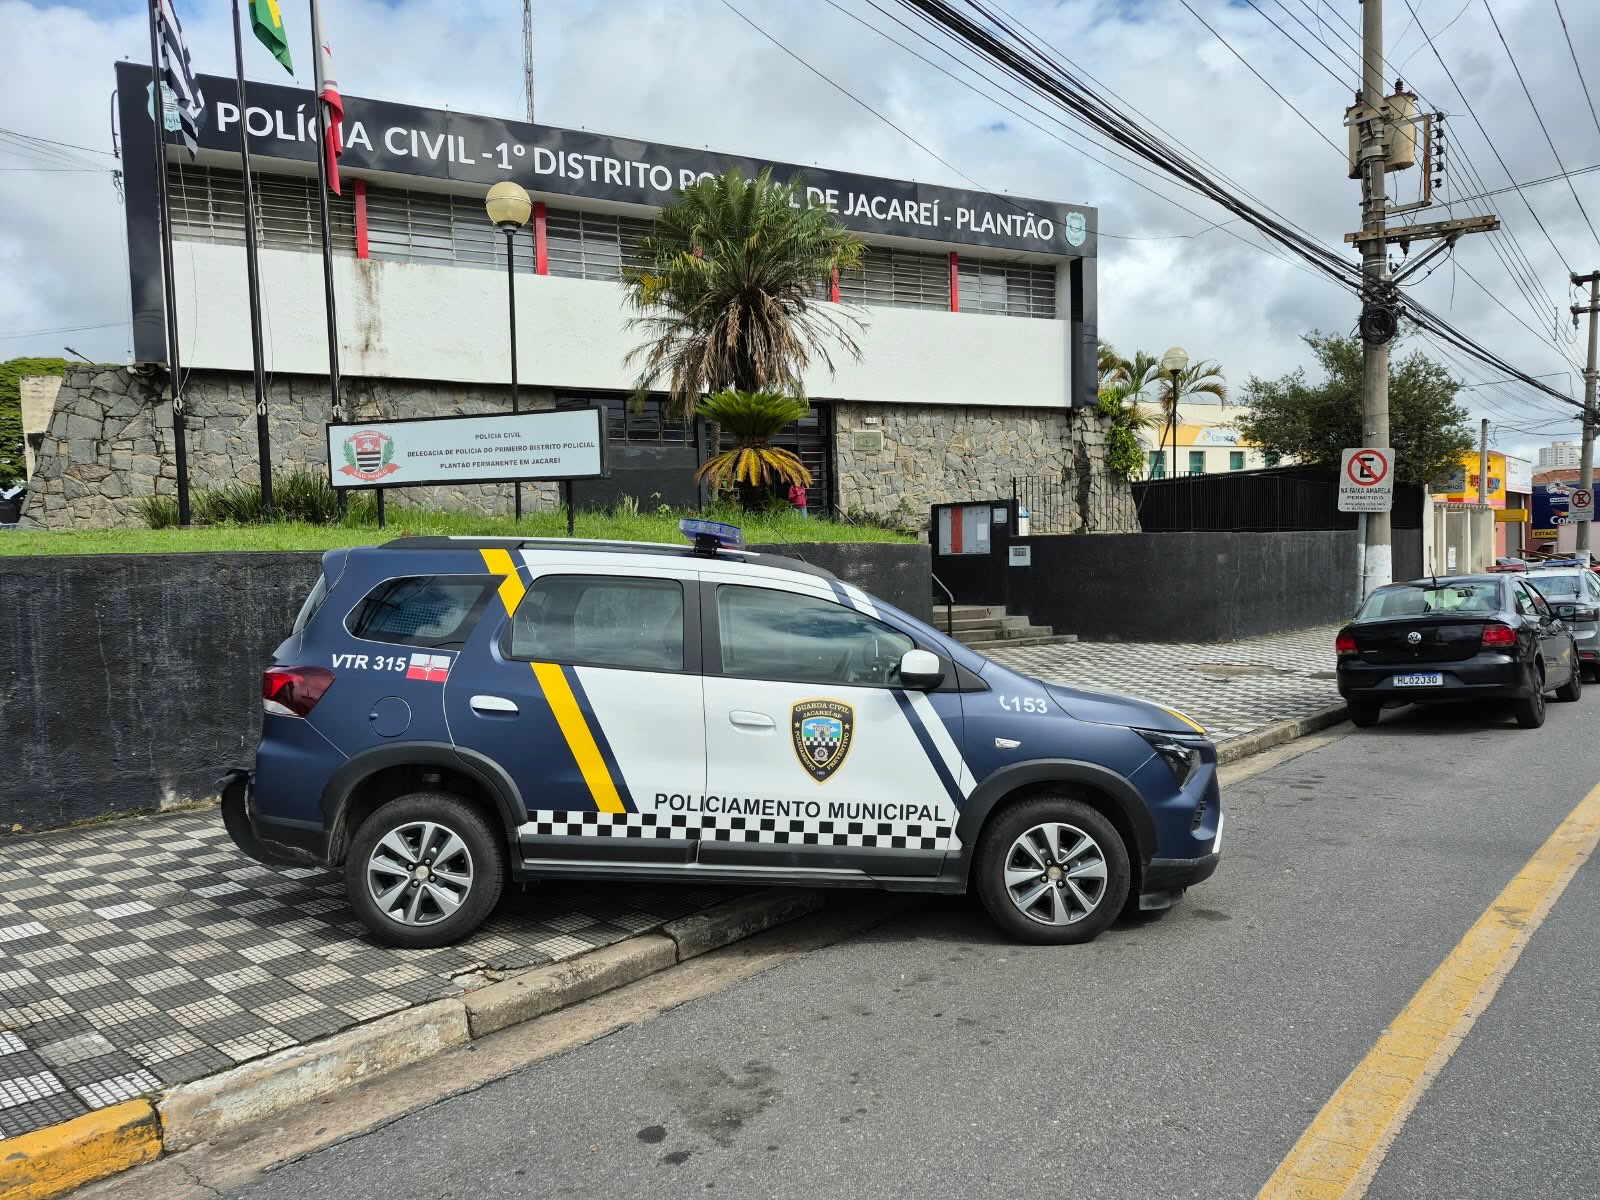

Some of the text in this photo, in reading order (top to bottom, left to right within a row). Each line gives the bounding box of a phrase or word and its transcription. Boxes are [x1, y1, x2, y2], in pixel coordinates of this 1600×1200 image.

[384, 127, 475, 165] CIVIL
[534, 147, 673, 192] DISTRITO
[844, 192, 940, 227] JACAREÍ
[957, 208, 1054, 240] PLANTÃO
[530, 443, 561, 451] DISTRITO
[473, 459, 518, 467] PERMANENTE
[332, 653, 407, 672] VTR 315
[795, 702, 850, 714] GUARDA CIVIL
[1011, 696, 1048, 713] 153
[795, 730, 816, 771] POLICIAMENTO
[826, 732, 850, 771] PREVENTIVO
[654, 793, 946, 821] POLICIAMENTO MUNICIPAL
